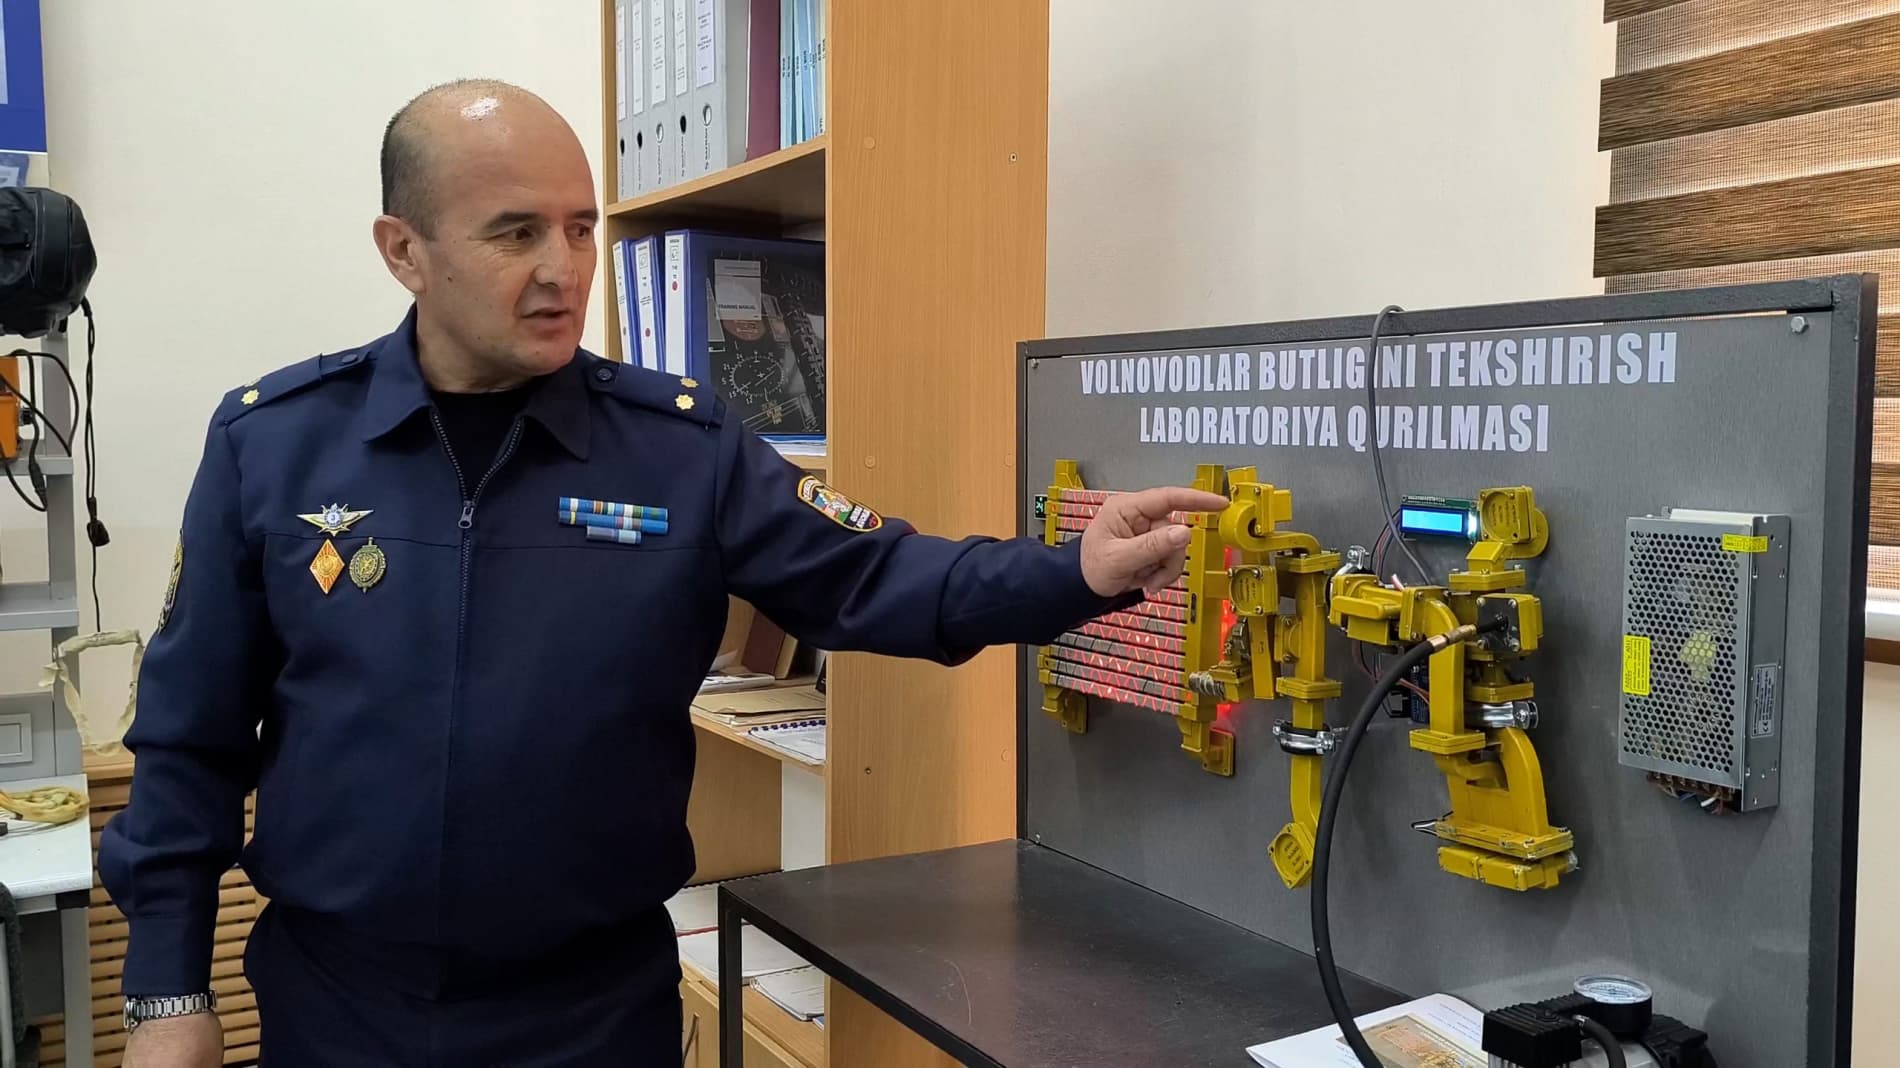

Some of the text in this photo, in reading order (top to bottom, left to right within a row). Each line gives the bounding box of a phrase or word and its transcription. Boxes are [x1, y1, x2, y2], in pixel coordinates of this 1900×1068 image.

[1080, 352, 1250, 394] VOLNOVODLAR
[1427, 332, 1677, 387] TEKSHIRISH
[1140, 404, 1549, 453] LABORATORIYA QURILMASI
